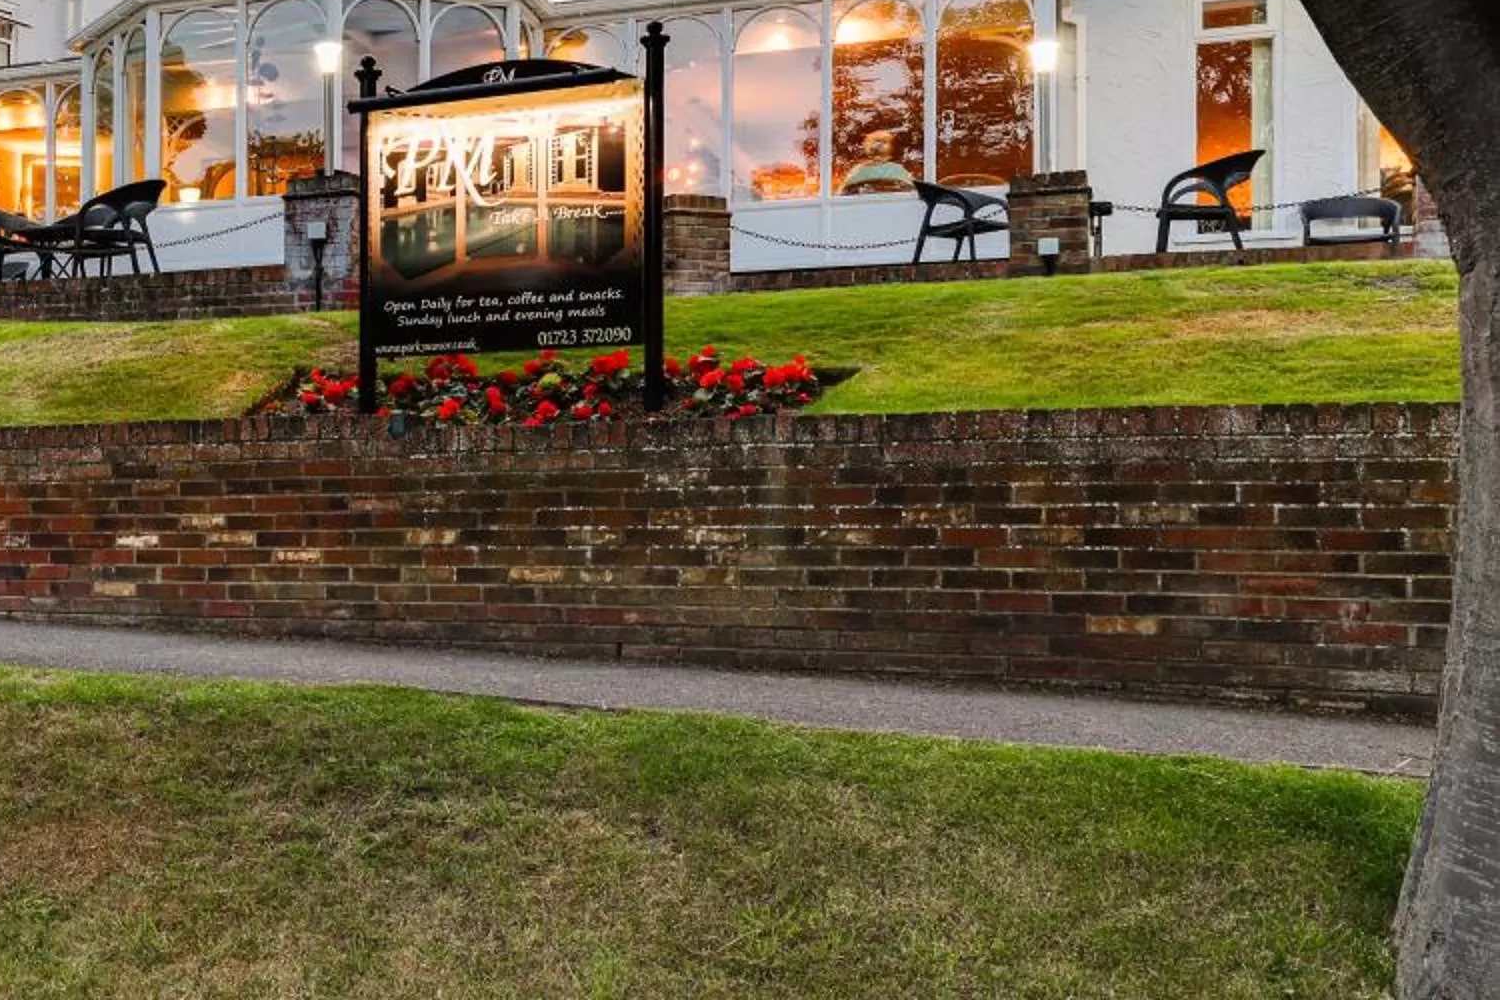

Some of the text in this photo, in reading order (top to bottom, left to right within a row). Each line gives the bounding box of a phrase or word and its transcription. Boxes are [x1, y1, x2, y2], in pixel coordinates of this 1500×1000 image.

[383, 300, 416, 314] Open
[420, 297, 452, 312] Daily
[455, 295, 475, 308] for
[507, 291, 545, 305] coffee
[549, 289, 575, 303] and
[397, 303, 606, 328] Sunday lunch and evening meals
[537, 325, 632, 345] 01723 372090
